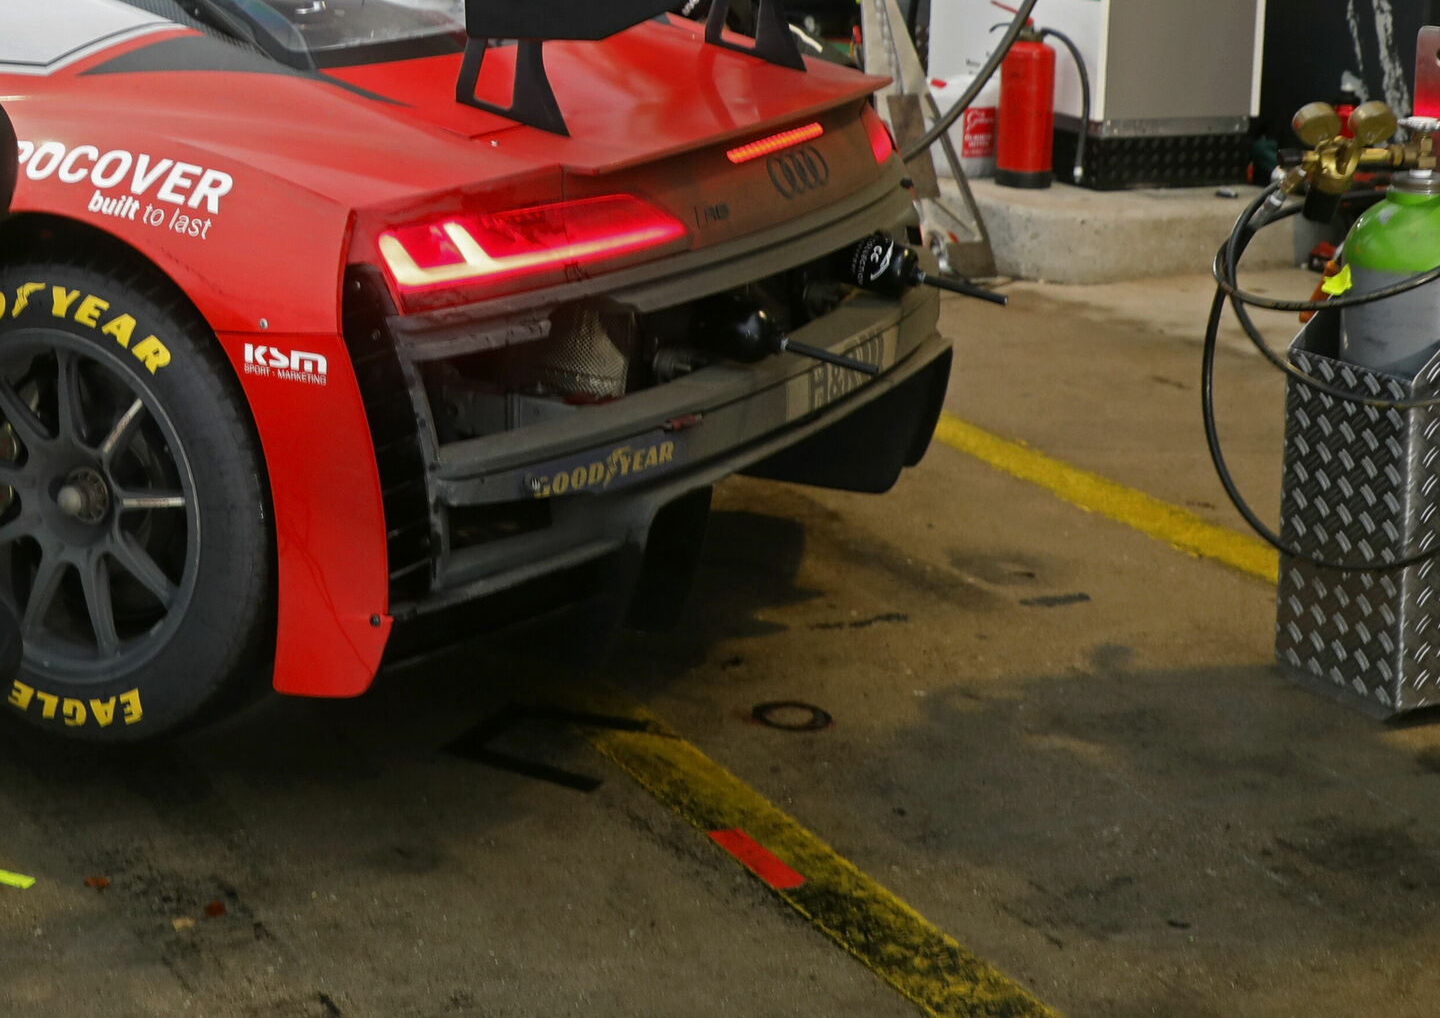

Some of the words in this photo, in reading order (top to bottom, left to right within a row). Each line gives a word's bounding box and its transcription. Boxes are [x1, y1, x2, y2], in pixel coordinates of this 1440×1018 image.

[88, 189, 141, 221] built
[142, 203, 166, 226] to
[169, 207, 213, 240] last
[244, 342, 328, 375] KSM
[244, 363, 271, 379] SPORT
[277, 369, 328, 387] MARKETING
[7, 679, 144, 728] EAGLE
